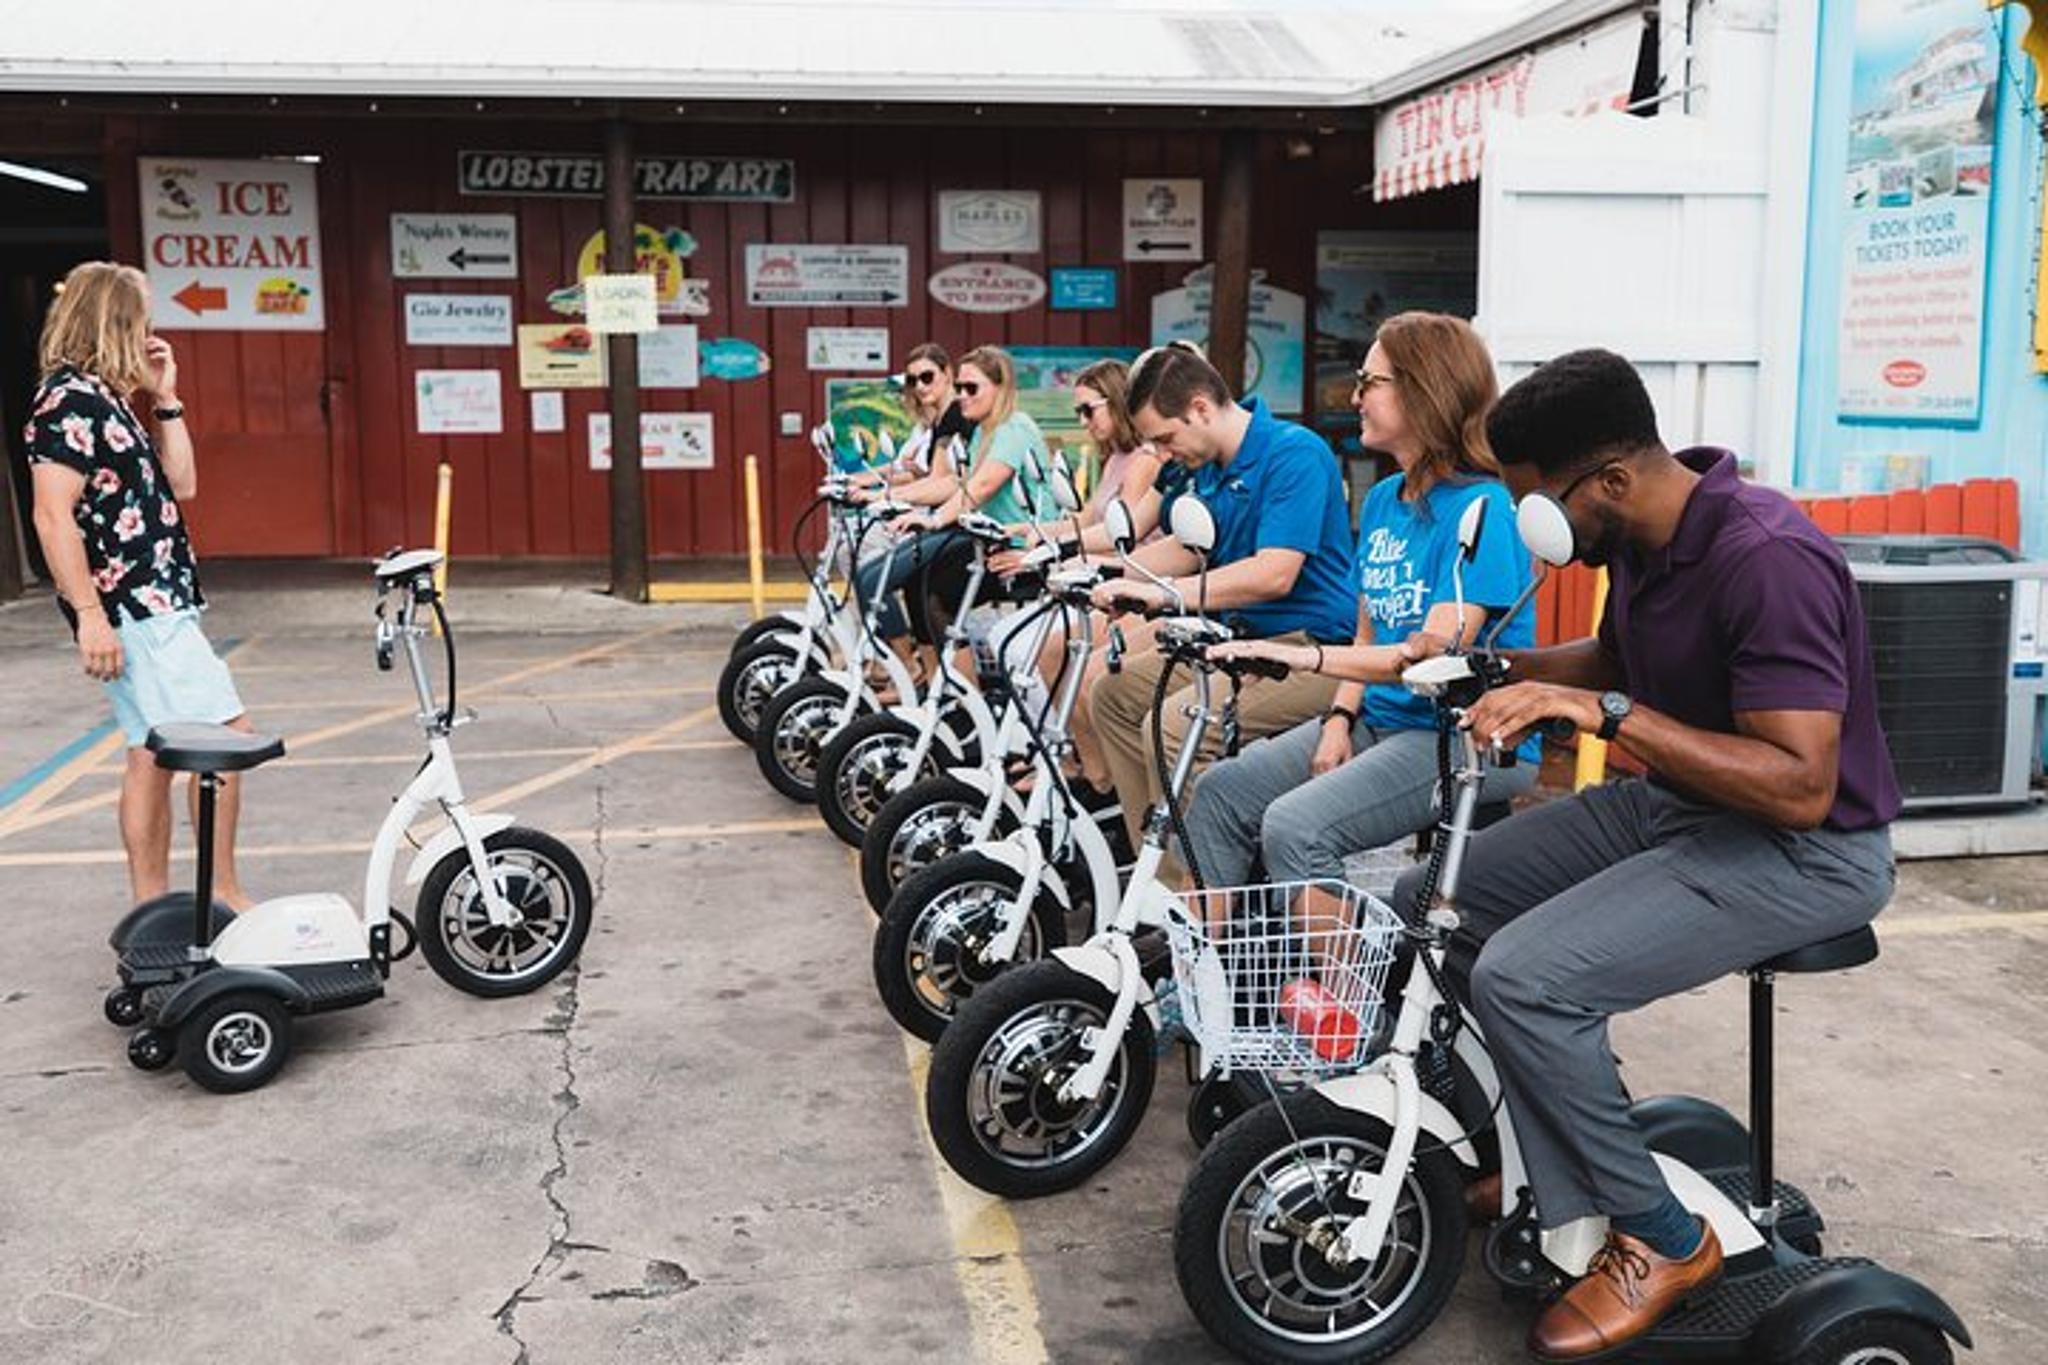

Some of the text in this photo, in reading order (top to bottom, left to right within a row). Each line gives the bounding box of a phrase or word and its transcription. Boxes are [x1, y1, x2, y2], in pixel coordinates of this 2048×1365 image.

[1396, 55, 1534, 158] TIN CITY
[637, 160, 709, 192] RAP
[714, 161, 783, 192] ART
[217, 181, 292, 216] ICE
[405, 222, 454, 242] Naples
[1868, 211, 1956, 241] BOOK YOUR
[153, 233, 313, 269] CREAM
[1856, 240, 1910, 264] TICKETS
[938, 277, 1038, 290] ENTRANCE
[943, 291, 968, 303] TO
[445, 302, 506, 321] Jewelry
